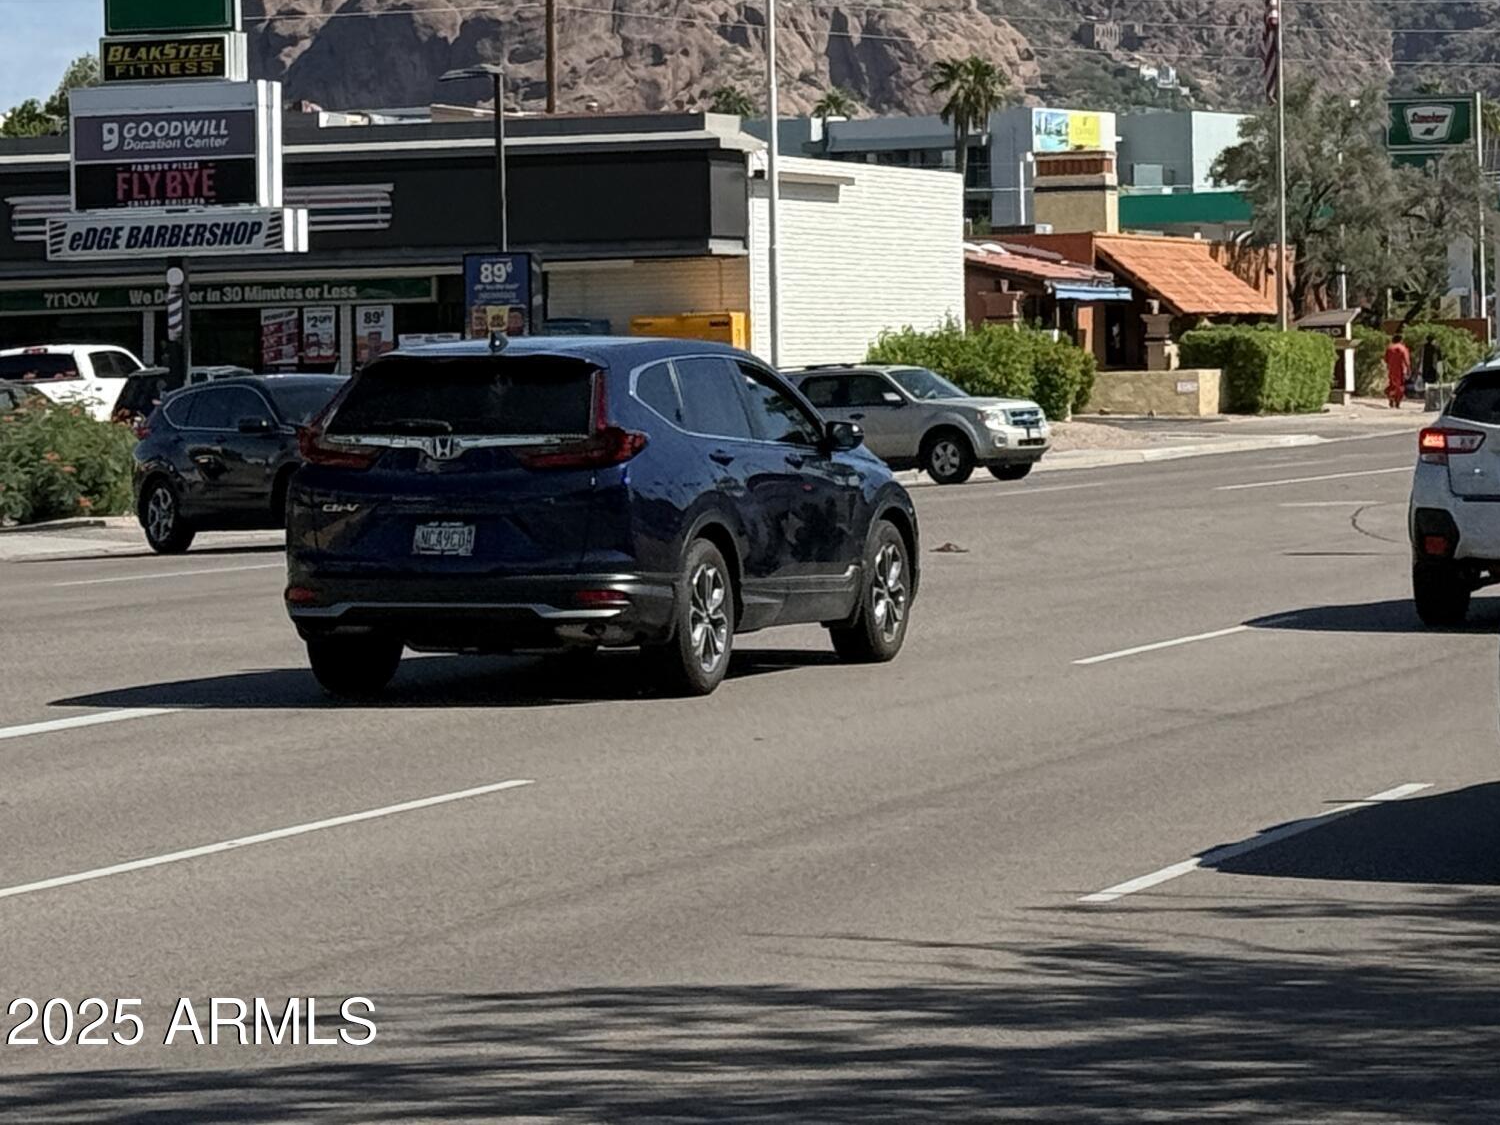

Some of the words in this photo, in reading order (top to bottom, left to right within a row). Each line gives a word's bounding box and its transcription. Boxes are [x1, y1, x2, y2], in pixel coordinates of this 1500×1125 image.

[115, 61, 215, 77] FITNESS
[123, 119, 229, 138] GOODWILL
[123, 137, 181, 151] Donation
[184, 135, 229, 149] Center
[116, 172, 160, 200] FLY
[165, 168, 216, 197] BYE
[124, 221, 264, 250] BARBERSHOP
[129, 289, 152, 305] We
[206, 287, 221, 303] in
[222, 286, 243, 303] 30
[244, 284, 304, 301] Minutes
[305, 286, 320, 300] or
[323, 283, 358, 299] Less
